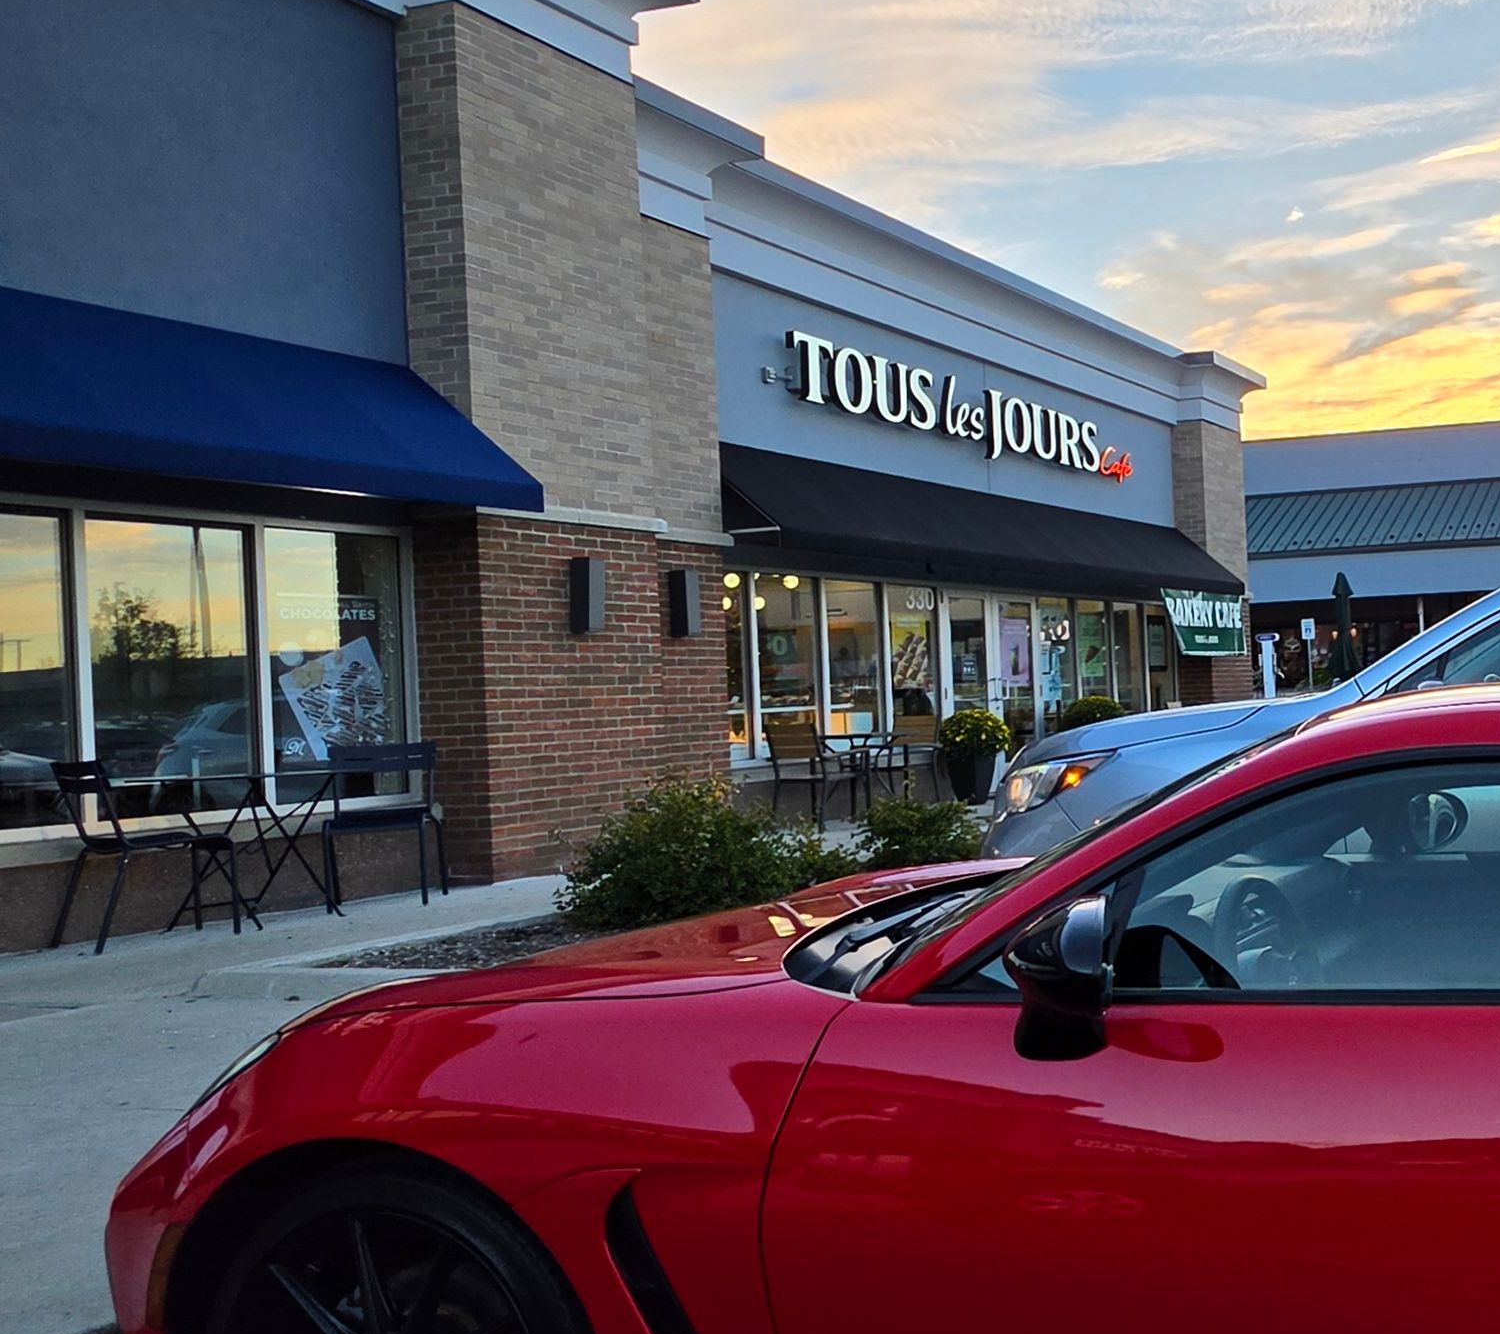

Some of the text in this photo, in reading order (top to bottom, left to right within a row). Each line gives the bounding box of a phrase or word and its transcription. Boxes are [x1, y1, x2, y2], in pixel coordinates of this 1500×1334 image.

[788, 330, 936, 431] TOUS
[942, 374, 984, 441] les
[984, 389, 1101, 473] JOURS
[905, 587, 935, 611] 330
[1165, 597, 1213, 627] BAKERY
